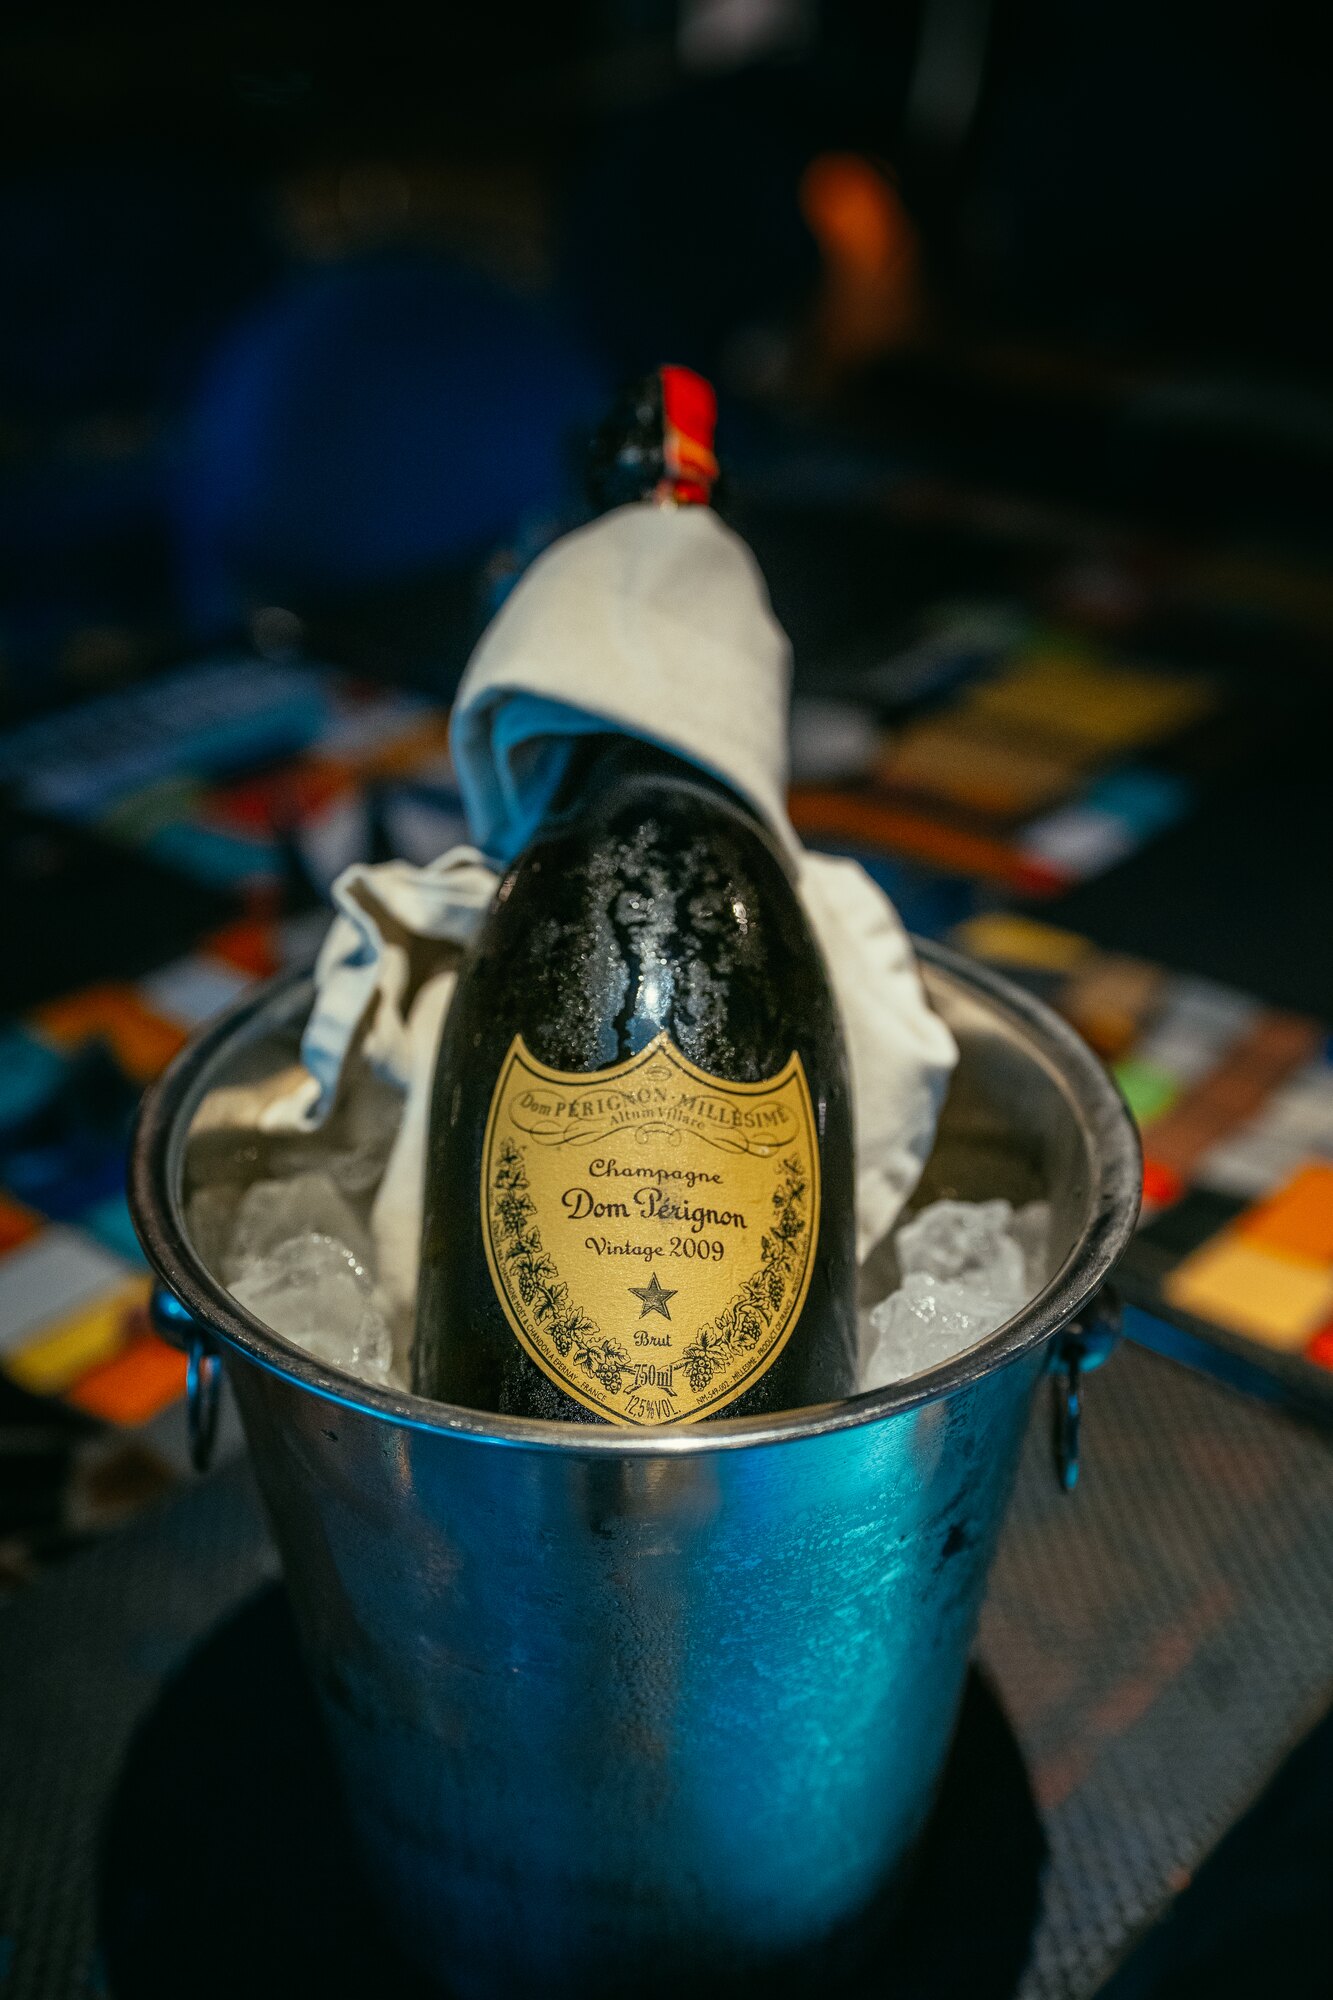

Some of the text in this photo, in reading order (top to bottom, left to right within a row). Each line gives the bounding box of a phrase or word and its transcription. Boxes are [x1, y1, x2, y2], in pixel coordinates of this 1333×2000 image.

[519, 1093, 552, 1116] Dom
[555, 1087, 667, 1118] PÉRIGNON
[610, 1109, 654, 1126] Altum
[589, 1158, 724, 1188] Champagne
[561, 1187, 748, 1233] Dom Pérignon
[585, 1236, 725, 1262] Vintage 2009
[633, 1330, 673, 1347] Brut
[757, 1329, 777, 1356] PRODUCT
[526, 1324, 551, 1356] CHANDON
[552, 1358, 579, 1381] EPERNAY
[580, 1381, 608, 1402] FRANCE
[633, 1363, 673, 1387] 750ml
